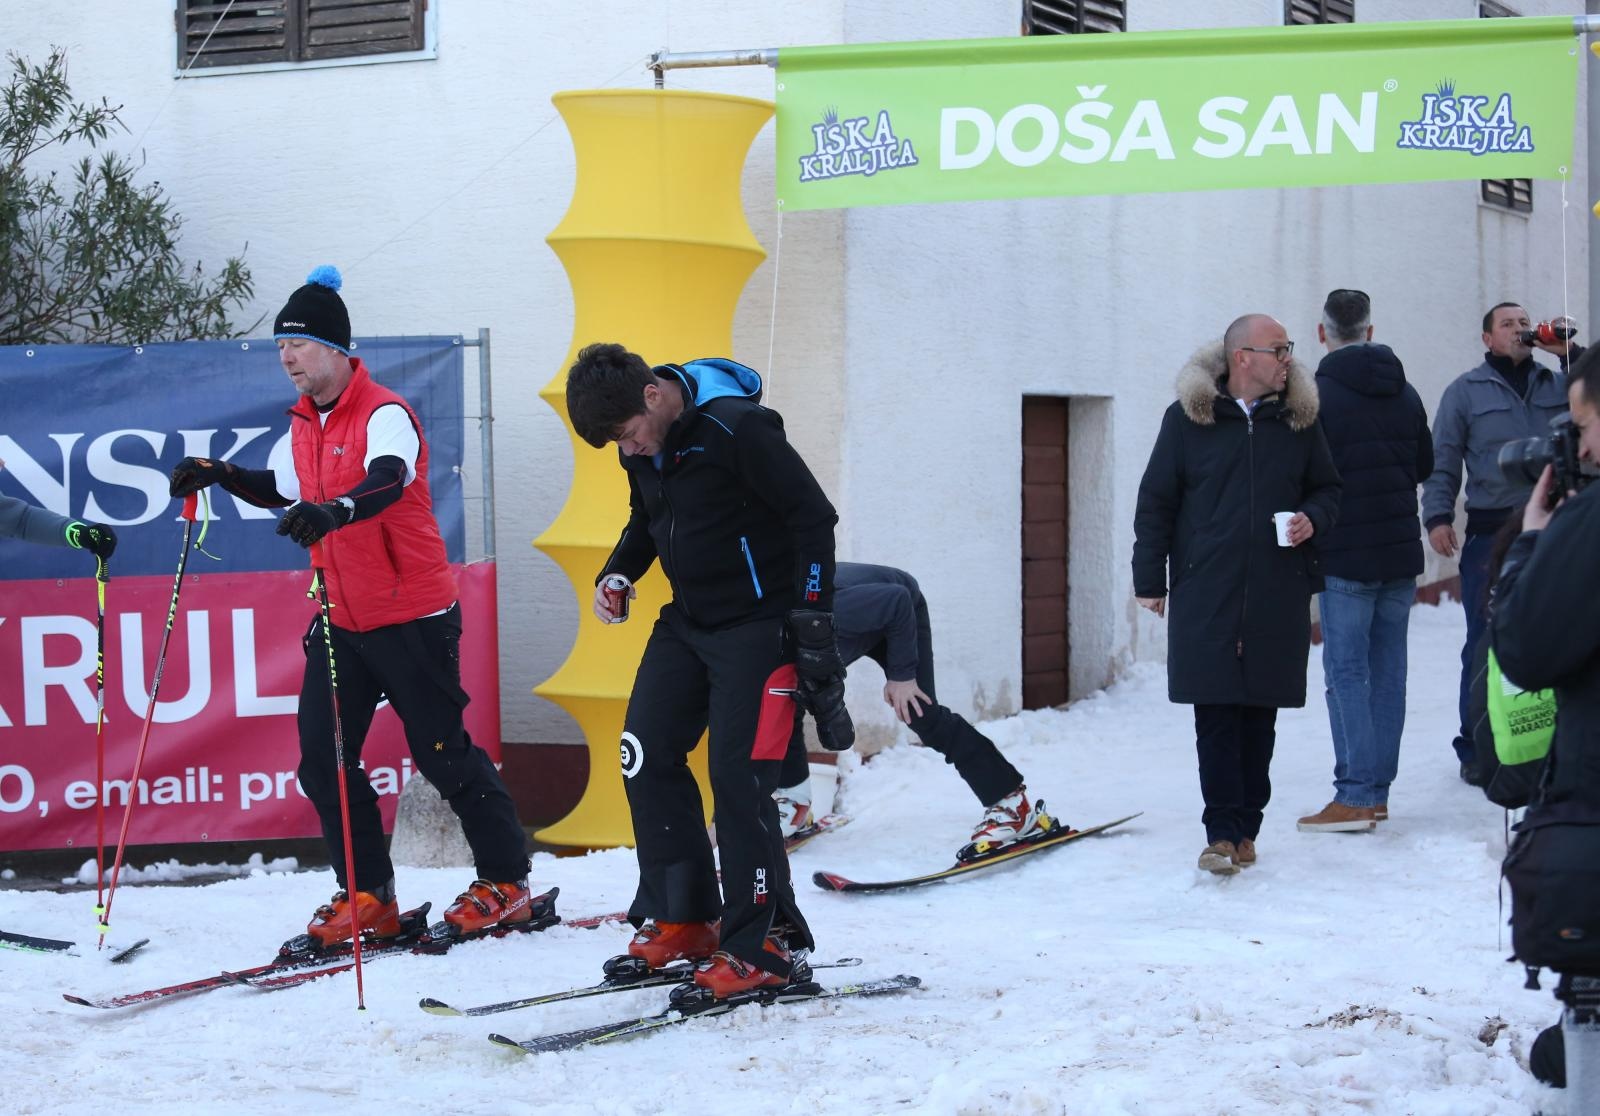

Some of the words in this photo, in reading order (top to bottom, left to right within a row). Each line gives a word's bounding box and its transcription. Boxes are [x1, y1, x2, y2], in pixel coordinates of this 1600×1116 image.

[940, 84, 1176, 171] DOŠA
[1421, 94, 1514, 128] ISKA
[812, 111, 897, 157] ISKA
[1398, 122, 1534, 155] KRALJICA
[800, 140, 918, 181] KRALJICA
[0, 426, 292, 527] NSK
[1511, 717, 1554, 737] MARATO
[64, 766, 224, 810] email:
